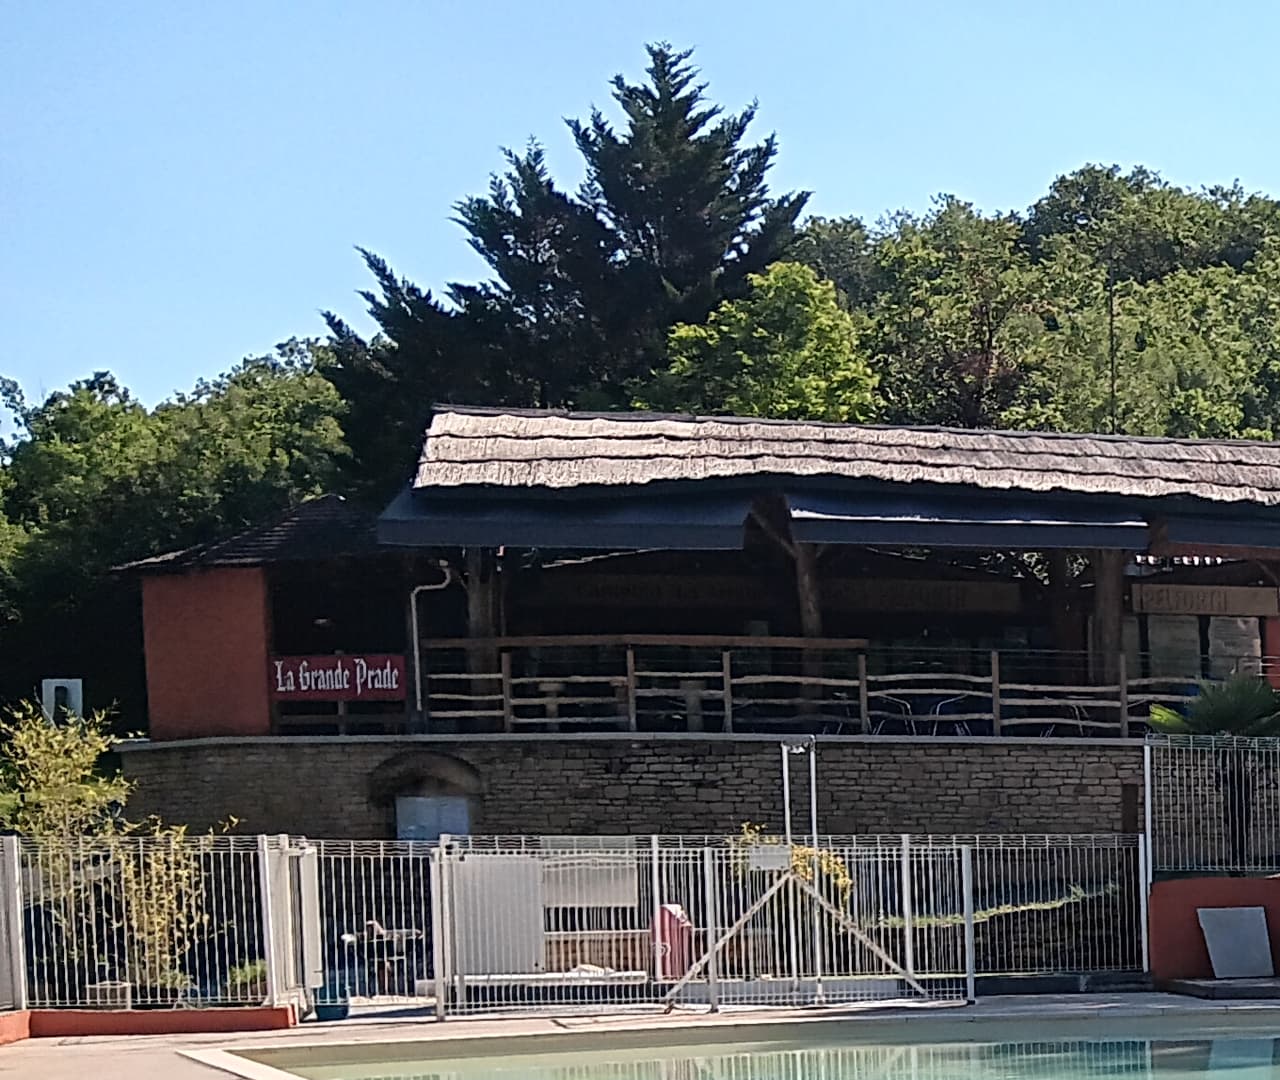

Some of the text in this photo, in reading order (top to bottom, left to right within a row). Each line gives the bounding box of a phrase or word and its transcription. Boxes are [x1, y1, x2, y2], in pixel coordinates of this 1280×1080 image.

[274, 657, 399, 696] La Grande Prade
